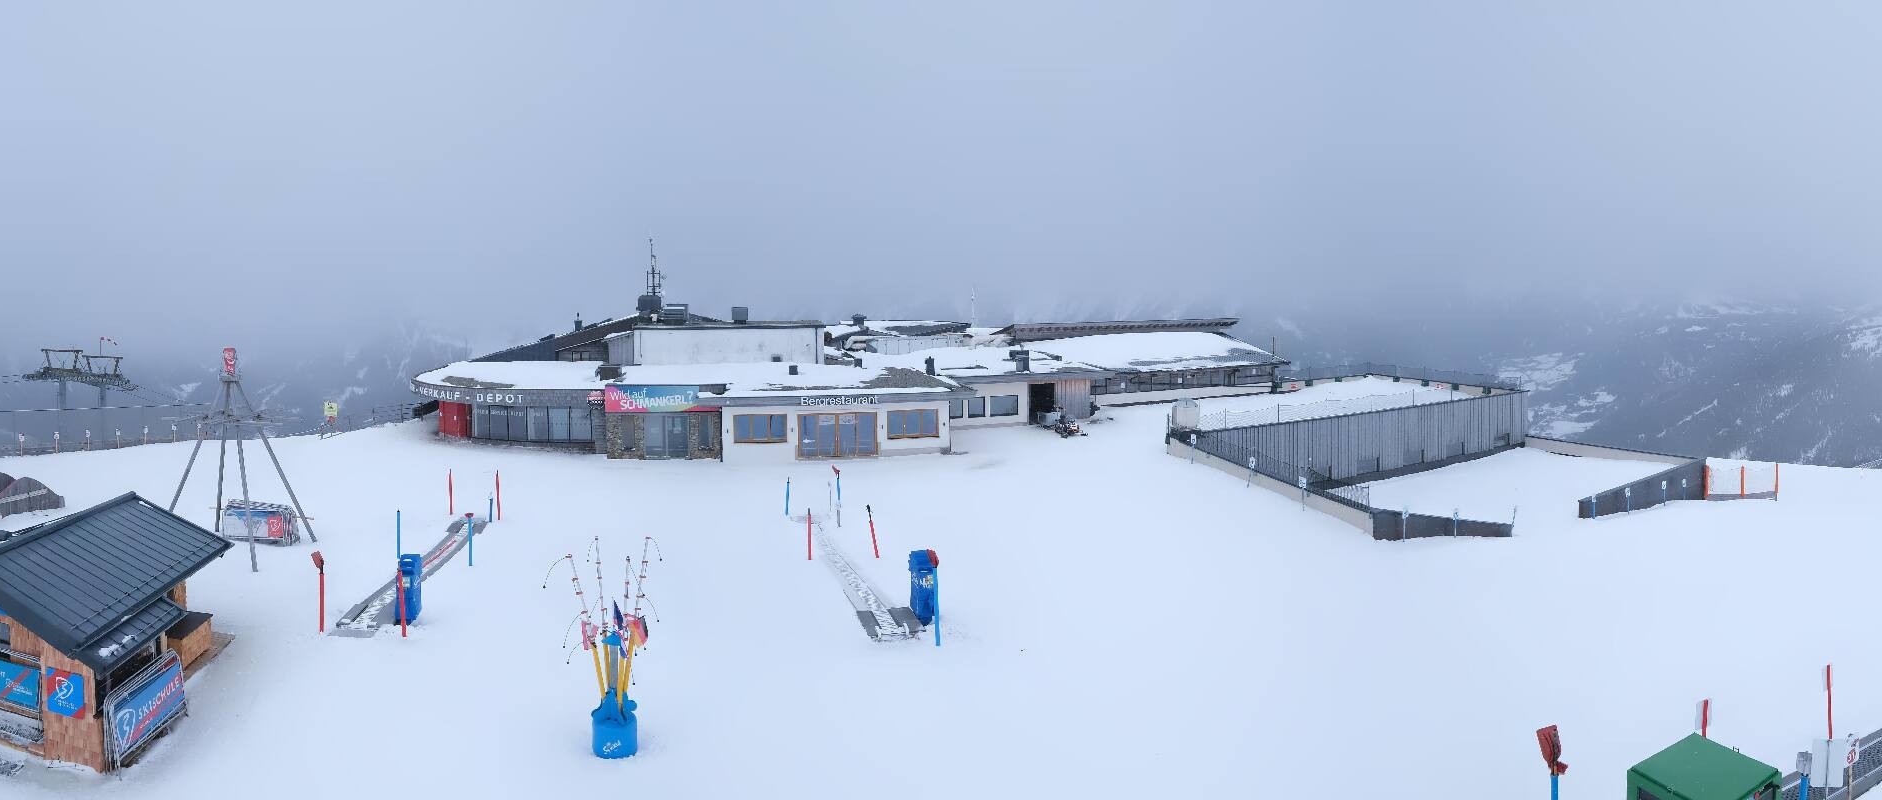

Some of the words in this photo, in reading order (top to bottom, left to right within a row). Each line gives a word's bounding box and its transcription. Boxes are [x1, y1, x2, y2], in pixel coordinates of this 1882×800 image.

[419, 387, 460, 400] VERKAUF
[476, 393, 524, 403] DEPOT
[610, 390, 631, 401] Wild
[632, 387, 647, 398] auf
[620, 391, 694, 410] SCHMANKERL?
[800, 395, 879, 407] Bergrestaurant
[138, 676, 180, 719] SKISCHULE
